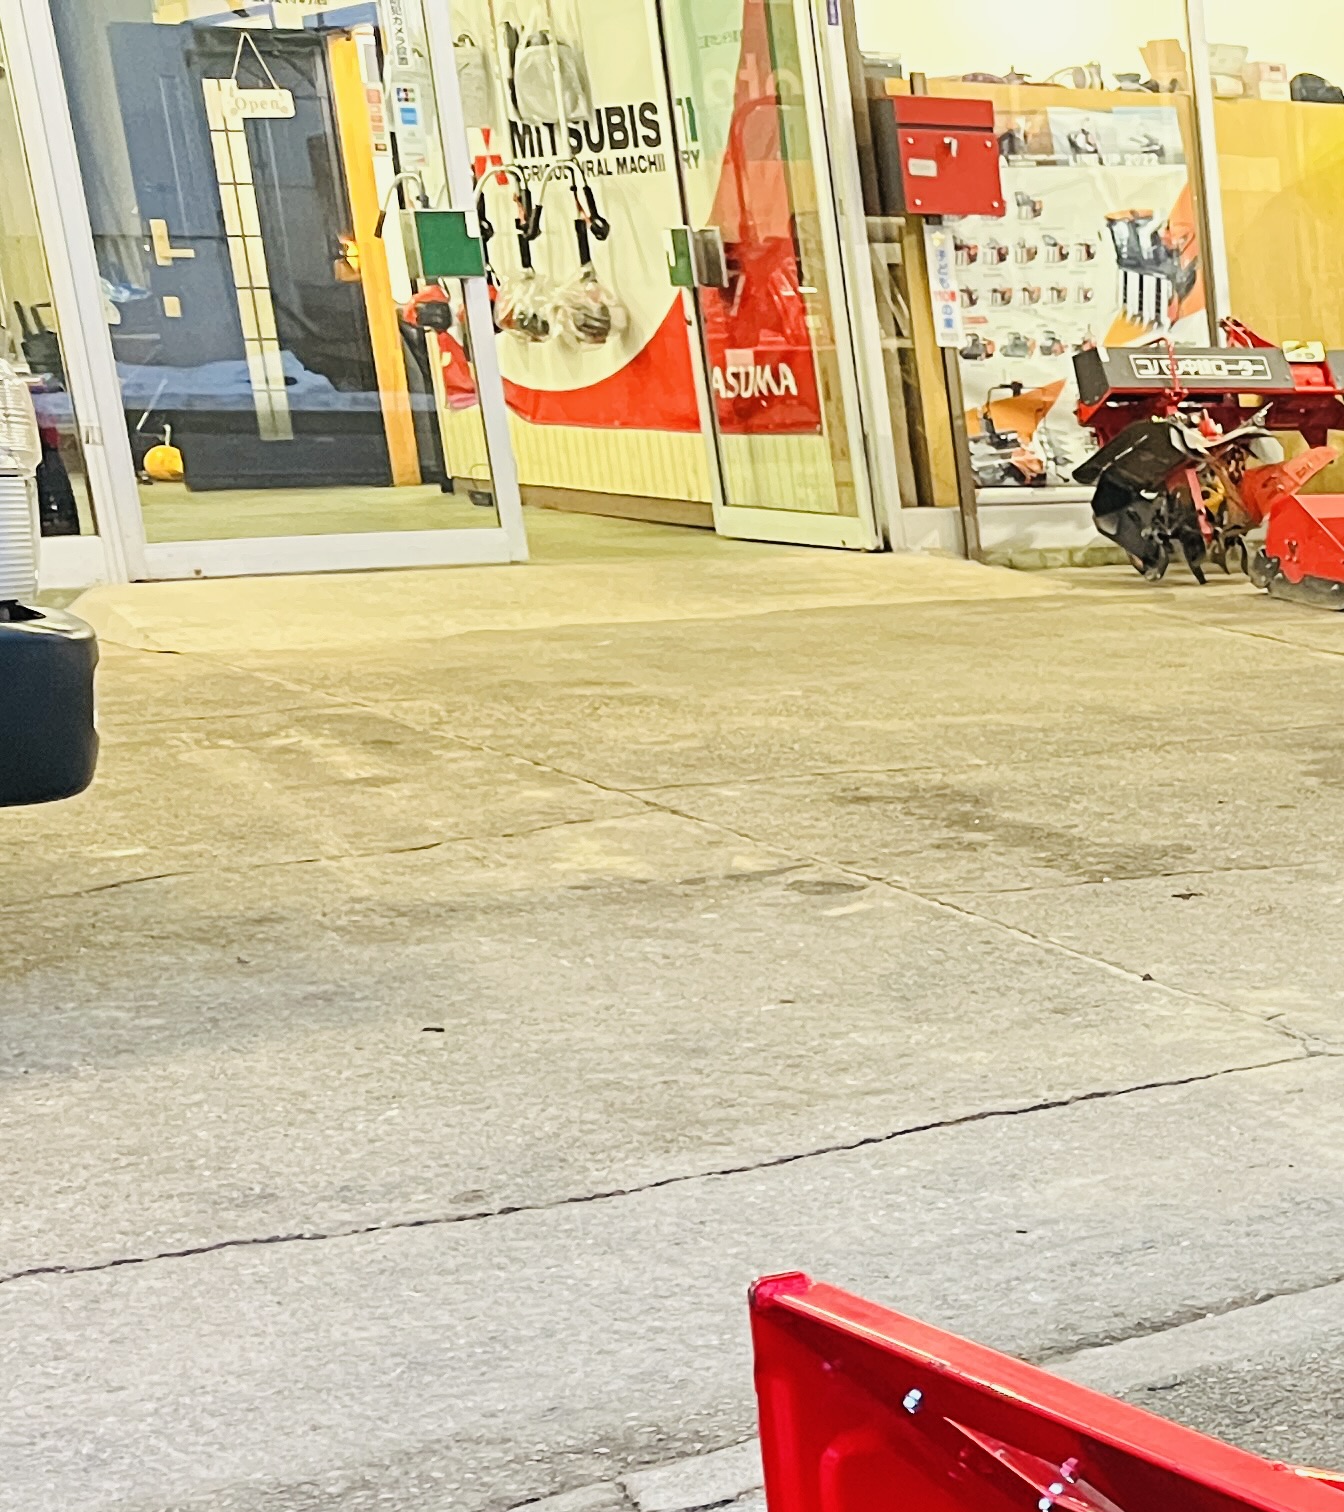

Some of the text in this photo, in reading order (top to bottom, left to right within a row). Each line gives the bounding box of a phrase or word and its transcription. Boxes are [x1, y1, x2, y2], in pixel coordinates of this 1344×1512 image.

[234, 97, 281, 114] Open
[509, 96, 698, 160] MITSUBISI
[712, 363, 798, 399] ASUMA
